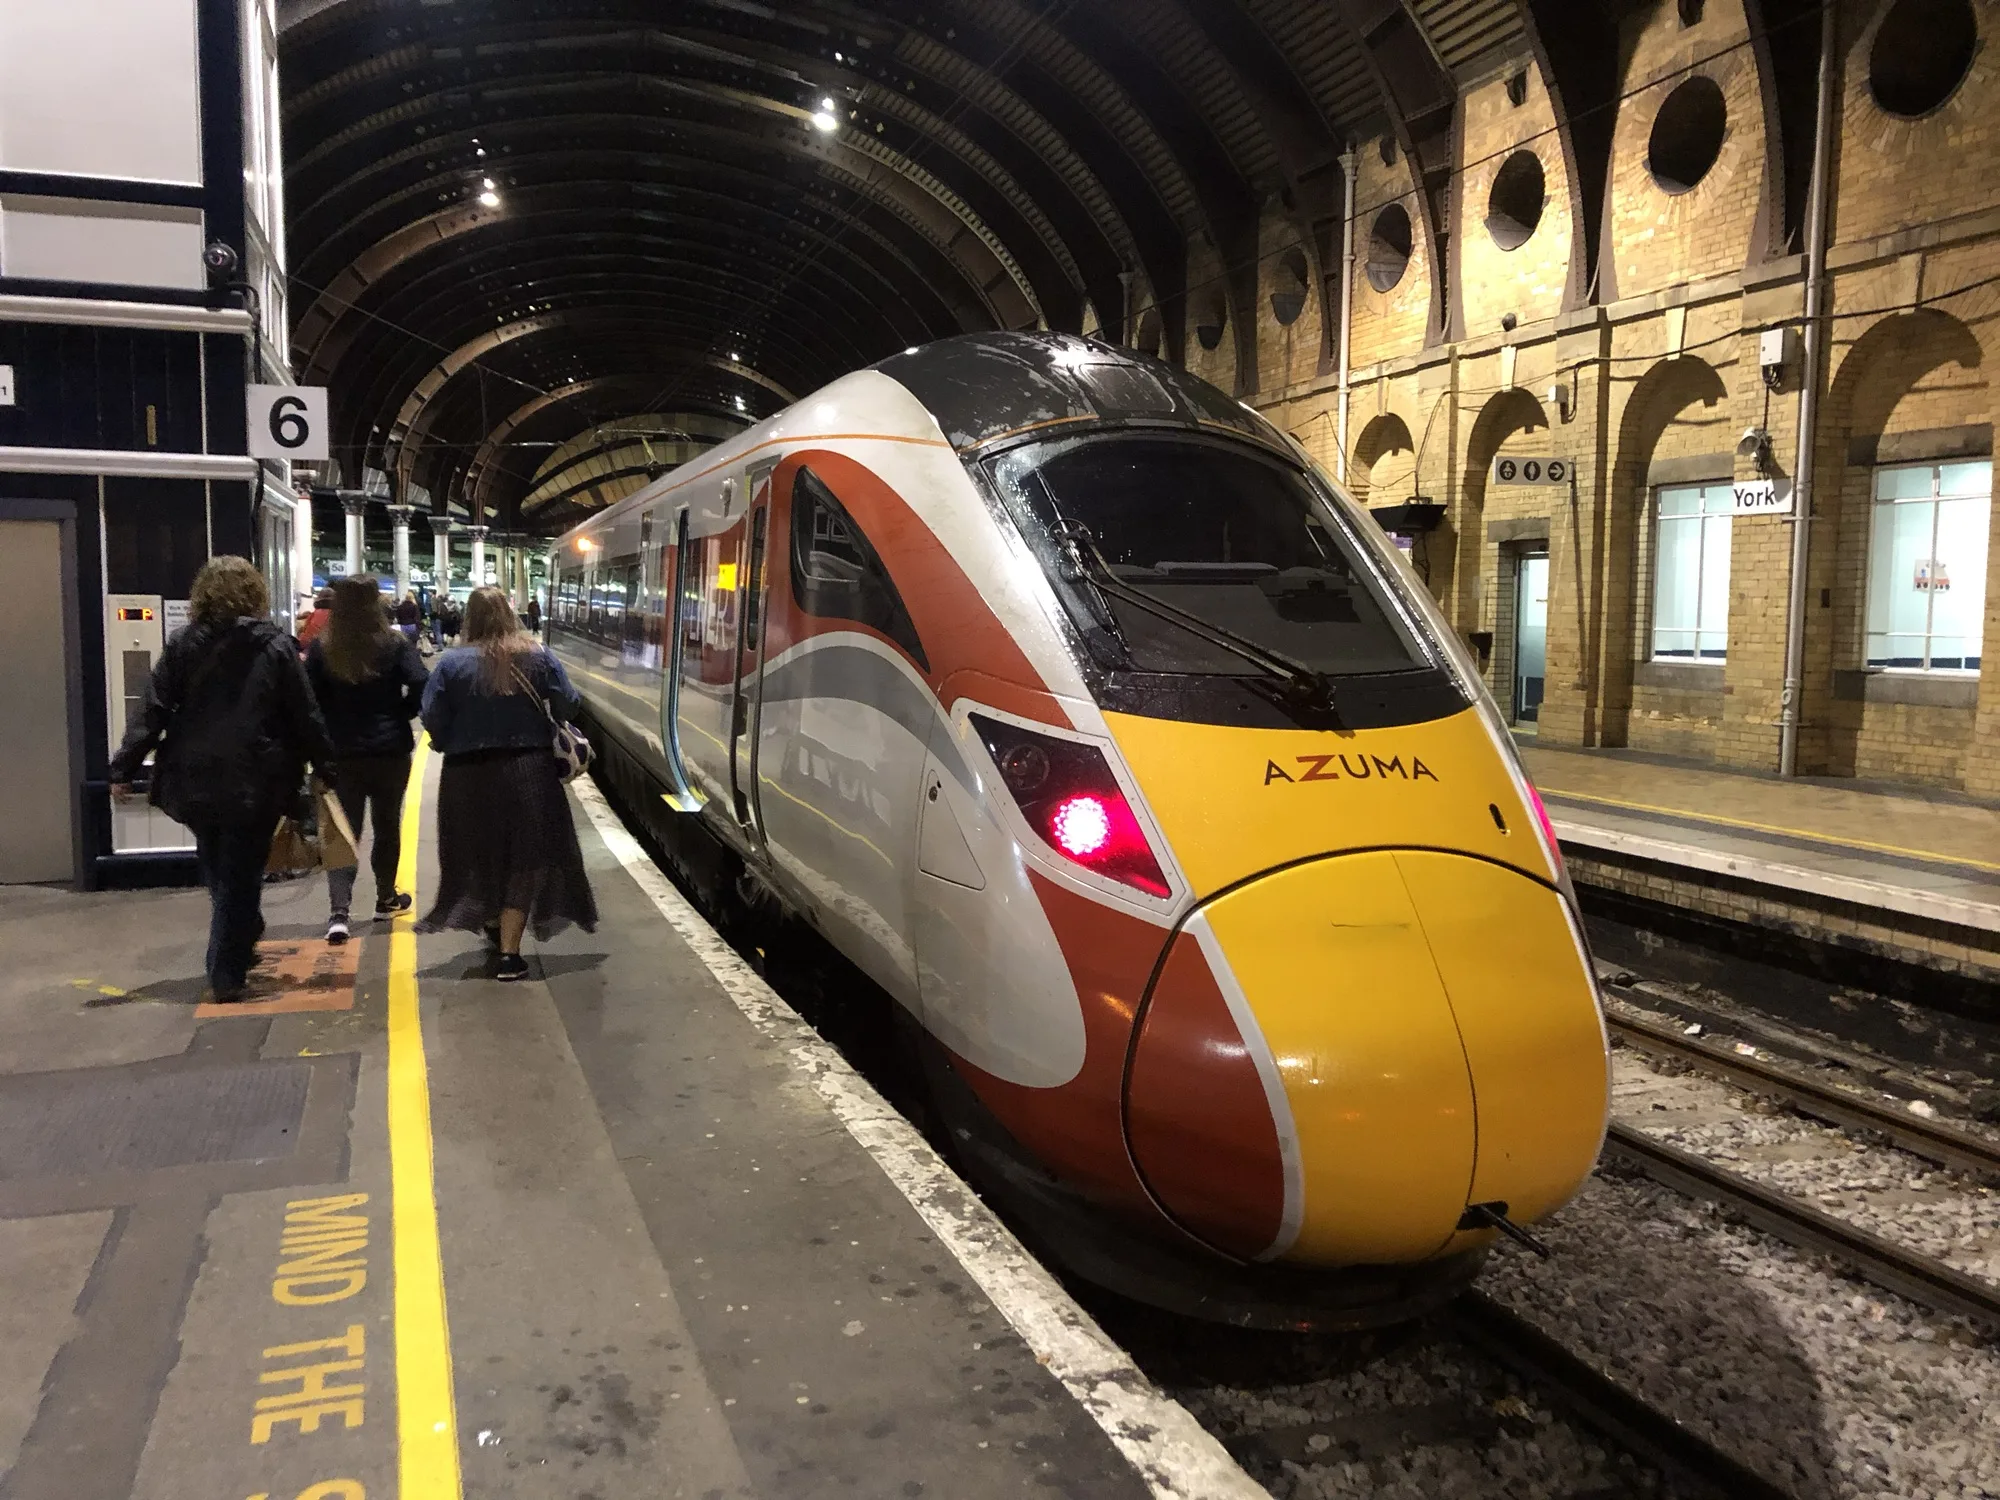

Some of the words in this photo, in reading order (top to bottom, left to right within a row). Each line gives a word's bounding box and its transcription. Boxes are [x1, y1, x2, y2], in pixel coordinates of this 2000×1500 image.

[269, 395, 309, 449] 6
[1733, 486, 1775, 508] York
[331, 563, 344, 572] 5a
[1264, 754, 1440, 786] AZUMA
[272, 1193, 369, 1305] MIND
[250, 1324, 365, 1445] THE
